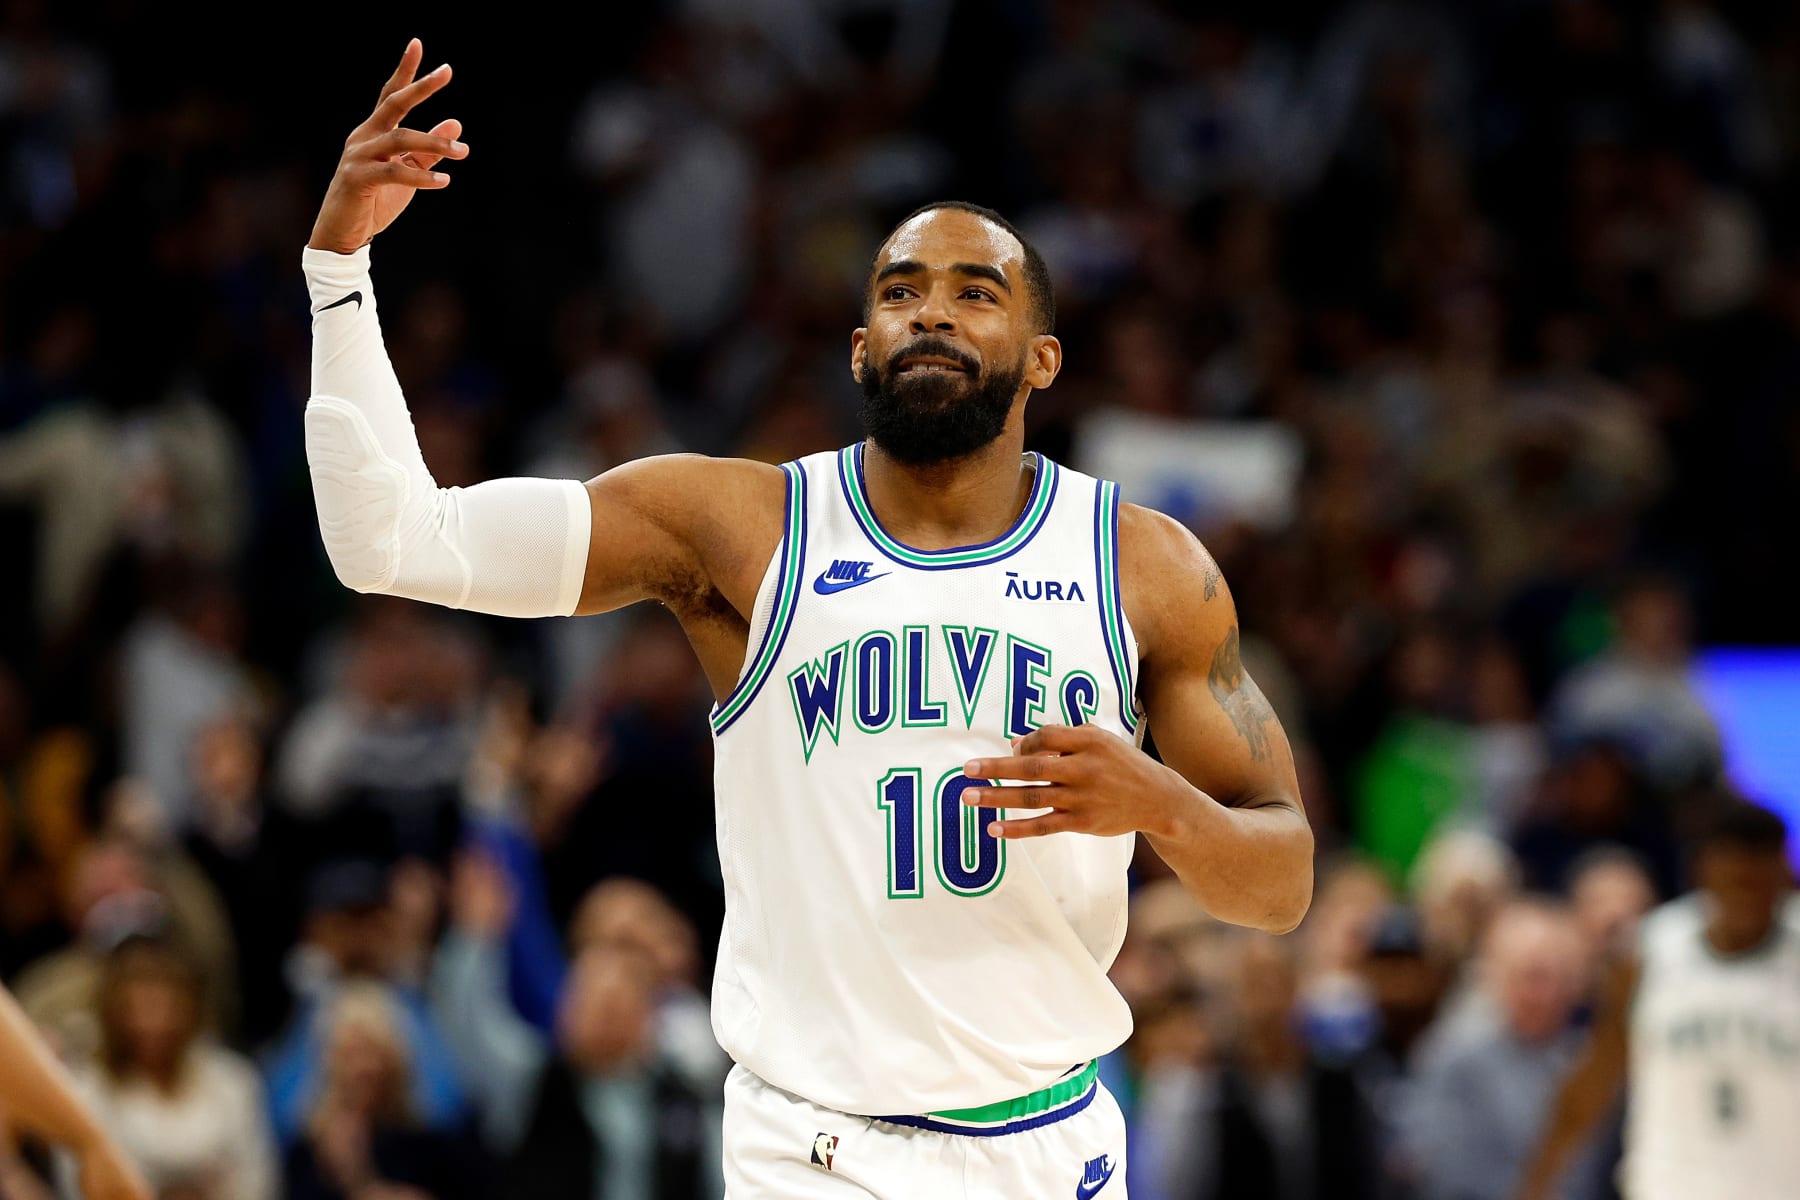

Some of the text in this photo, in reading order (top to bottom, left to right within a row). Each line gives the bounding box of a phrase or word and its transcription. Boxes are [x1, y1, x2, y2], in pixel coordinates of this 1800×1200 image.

[826, 559, 874, 581] NIKE
[877, 766, 1007, 900] 10
[1084, 1153, 1109, 1185] NIKE
